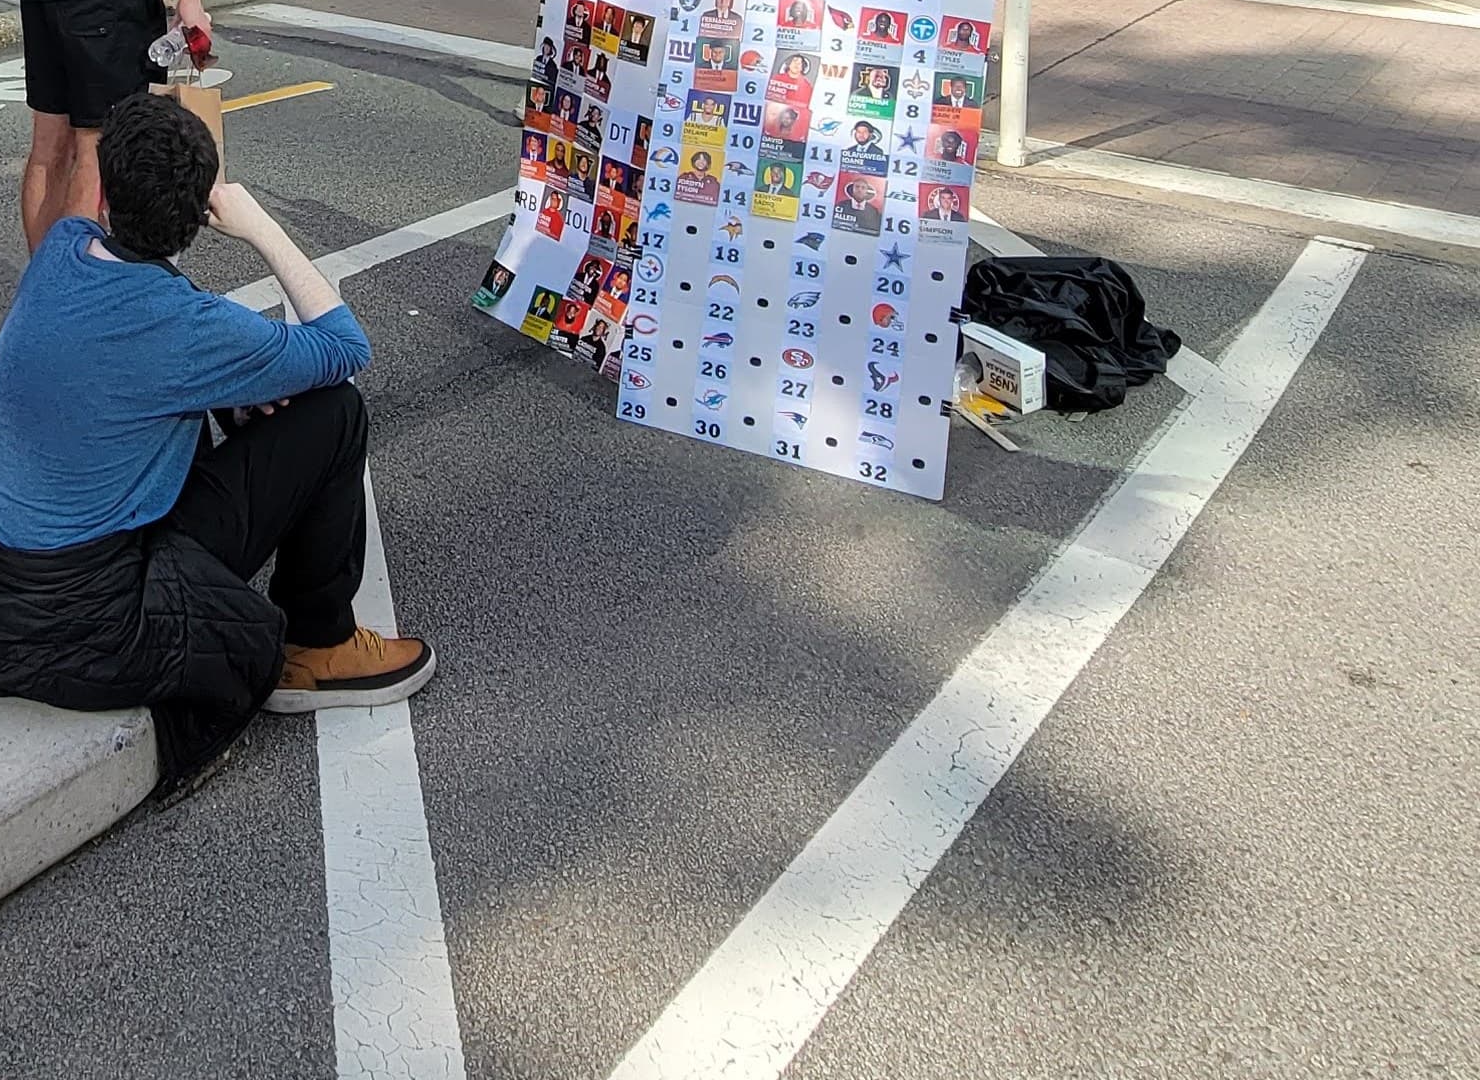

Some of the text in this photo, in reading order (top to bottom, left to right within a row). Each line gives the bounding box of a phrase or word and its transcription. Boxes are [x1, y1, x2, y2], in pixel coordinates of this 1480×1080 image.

[747, 2, 777, 14] JETS
[680, 19, 689, 32] 1
[751, 28, 764, 42] 2
[830, 38, 843, 52] 3
[912, 49, 927, 63] 4
[671, 70, 684, 84] 5
[745, 81, 757, 95] 6
[824, 92, 836, 106] 7
[906, 104, 919, 118] 8
[609, 123, 631, 145] DT
[662, 123, 674, 137] 9
[730, 133, 754, 149] 10
[761, 135, 784, 145] DAVID
[810, 145, 833, 163] 11
[892, 159, 918, 176] 12
[648, 176, 671, 193] 13
[519, 191, 537, 212] RB
[722, 189, 747, 206] 14
[886, 191, 918, 203] JETS
[801, 203, 827, 220] 15
[834, 212, 857, 223] ALLEN
[565, 209, 591, 234] IOL
[884, 217, 911, 235] 16
[641, 232, 665, 249] 17
[715, 246, 740, 263] 18
[794, 261, 820, 279] 19
[876, 277, 905, 295] 20
[635, 288, 658, 305] 21
[708, 303, 735, 321] 22
[788, 320, 815, 338] 23
[628, 344, 652, 362] 25
[871, 338, 900, 357] 24
[701, 361, 727, 379] 26
[781, 379, 808, 399] 27
[989, 372, 1018, 395] KN95
[622, 401, 646, 419] 29
[865, 399, 893, 419] 28
[695, 419, 721, 438] 30
[776, 440, 801, 460] 31
[859, 462, 887, 482] 32
